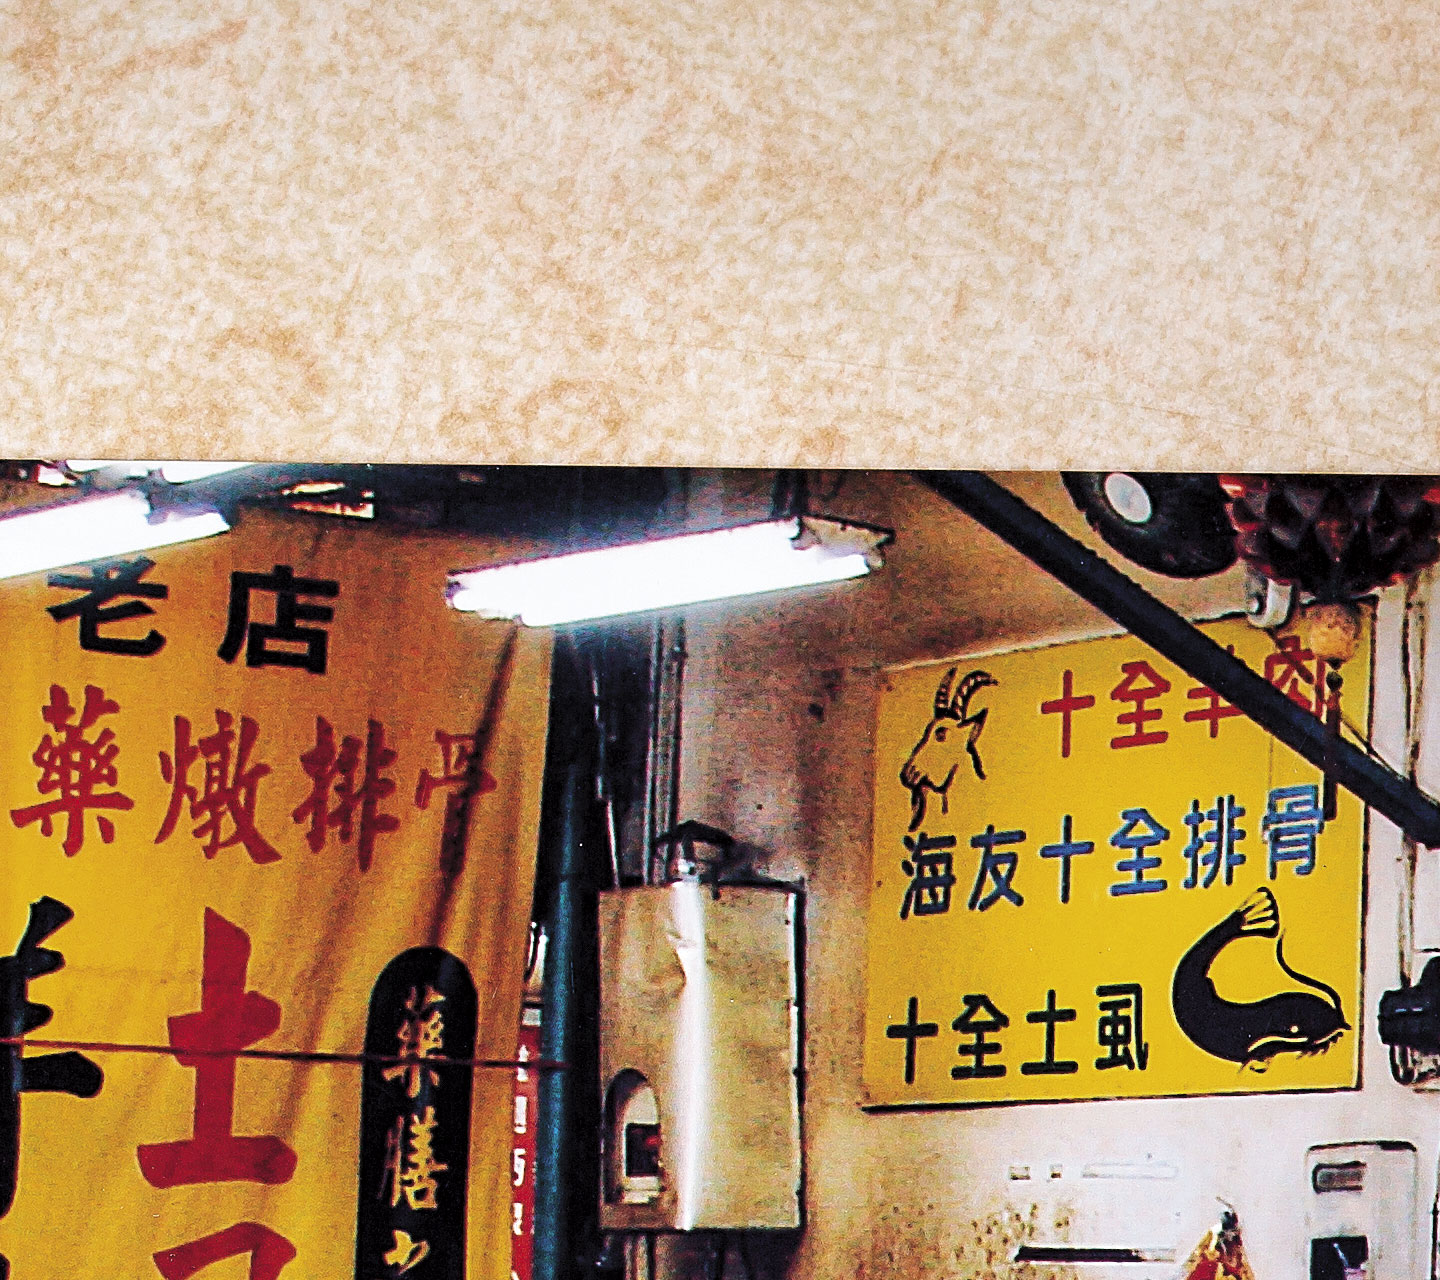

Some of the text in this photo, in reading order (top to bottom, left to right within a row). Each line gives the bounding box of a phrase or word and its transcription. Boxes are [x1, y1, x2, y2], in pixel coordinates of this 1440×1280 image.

[900, 783, 1326, 921] 海友十全排骨
